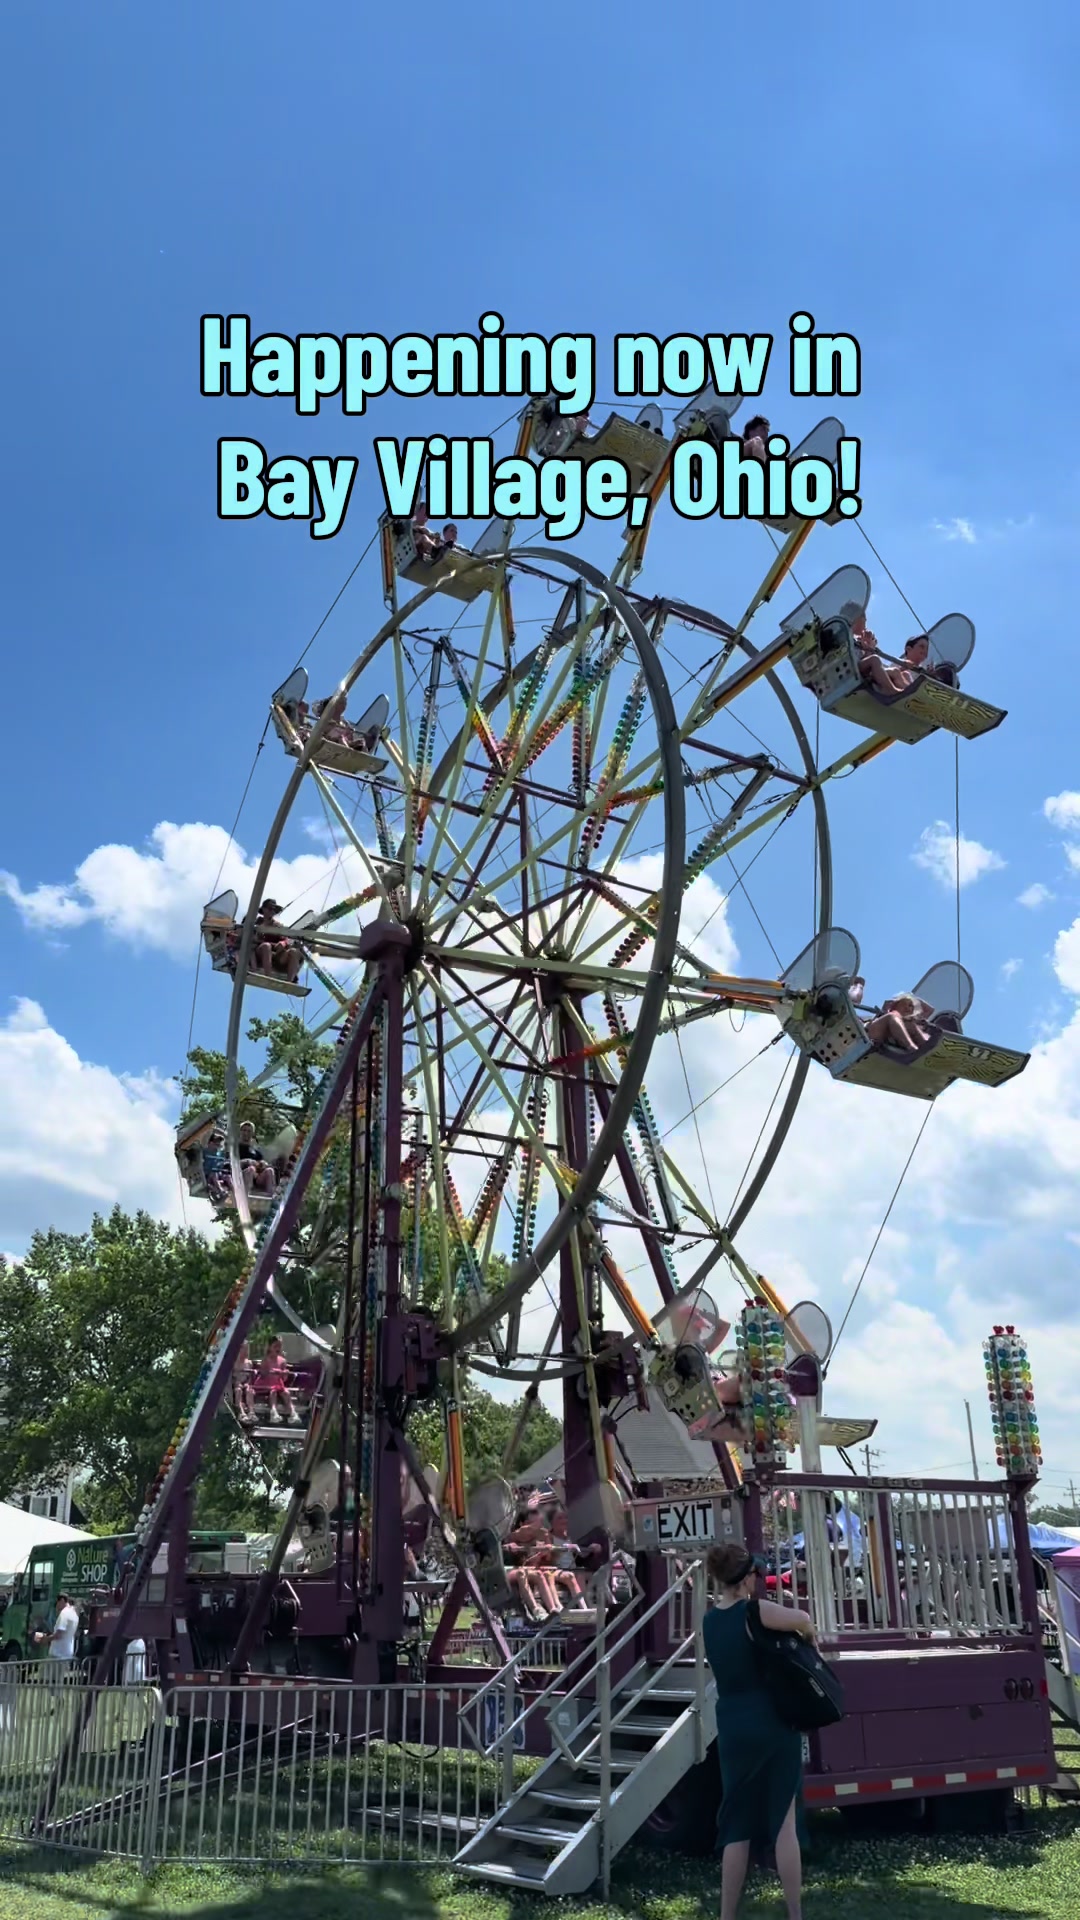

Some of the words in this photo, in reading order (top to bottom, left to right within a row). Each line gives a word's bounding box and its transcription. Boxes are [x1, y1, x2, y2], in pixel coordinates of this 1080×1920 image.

[657, 1503, 712, 1539] EXIT
[77, 1544, 109, 1563] Nature
[80, 1564, 108, 1583] SHOP
